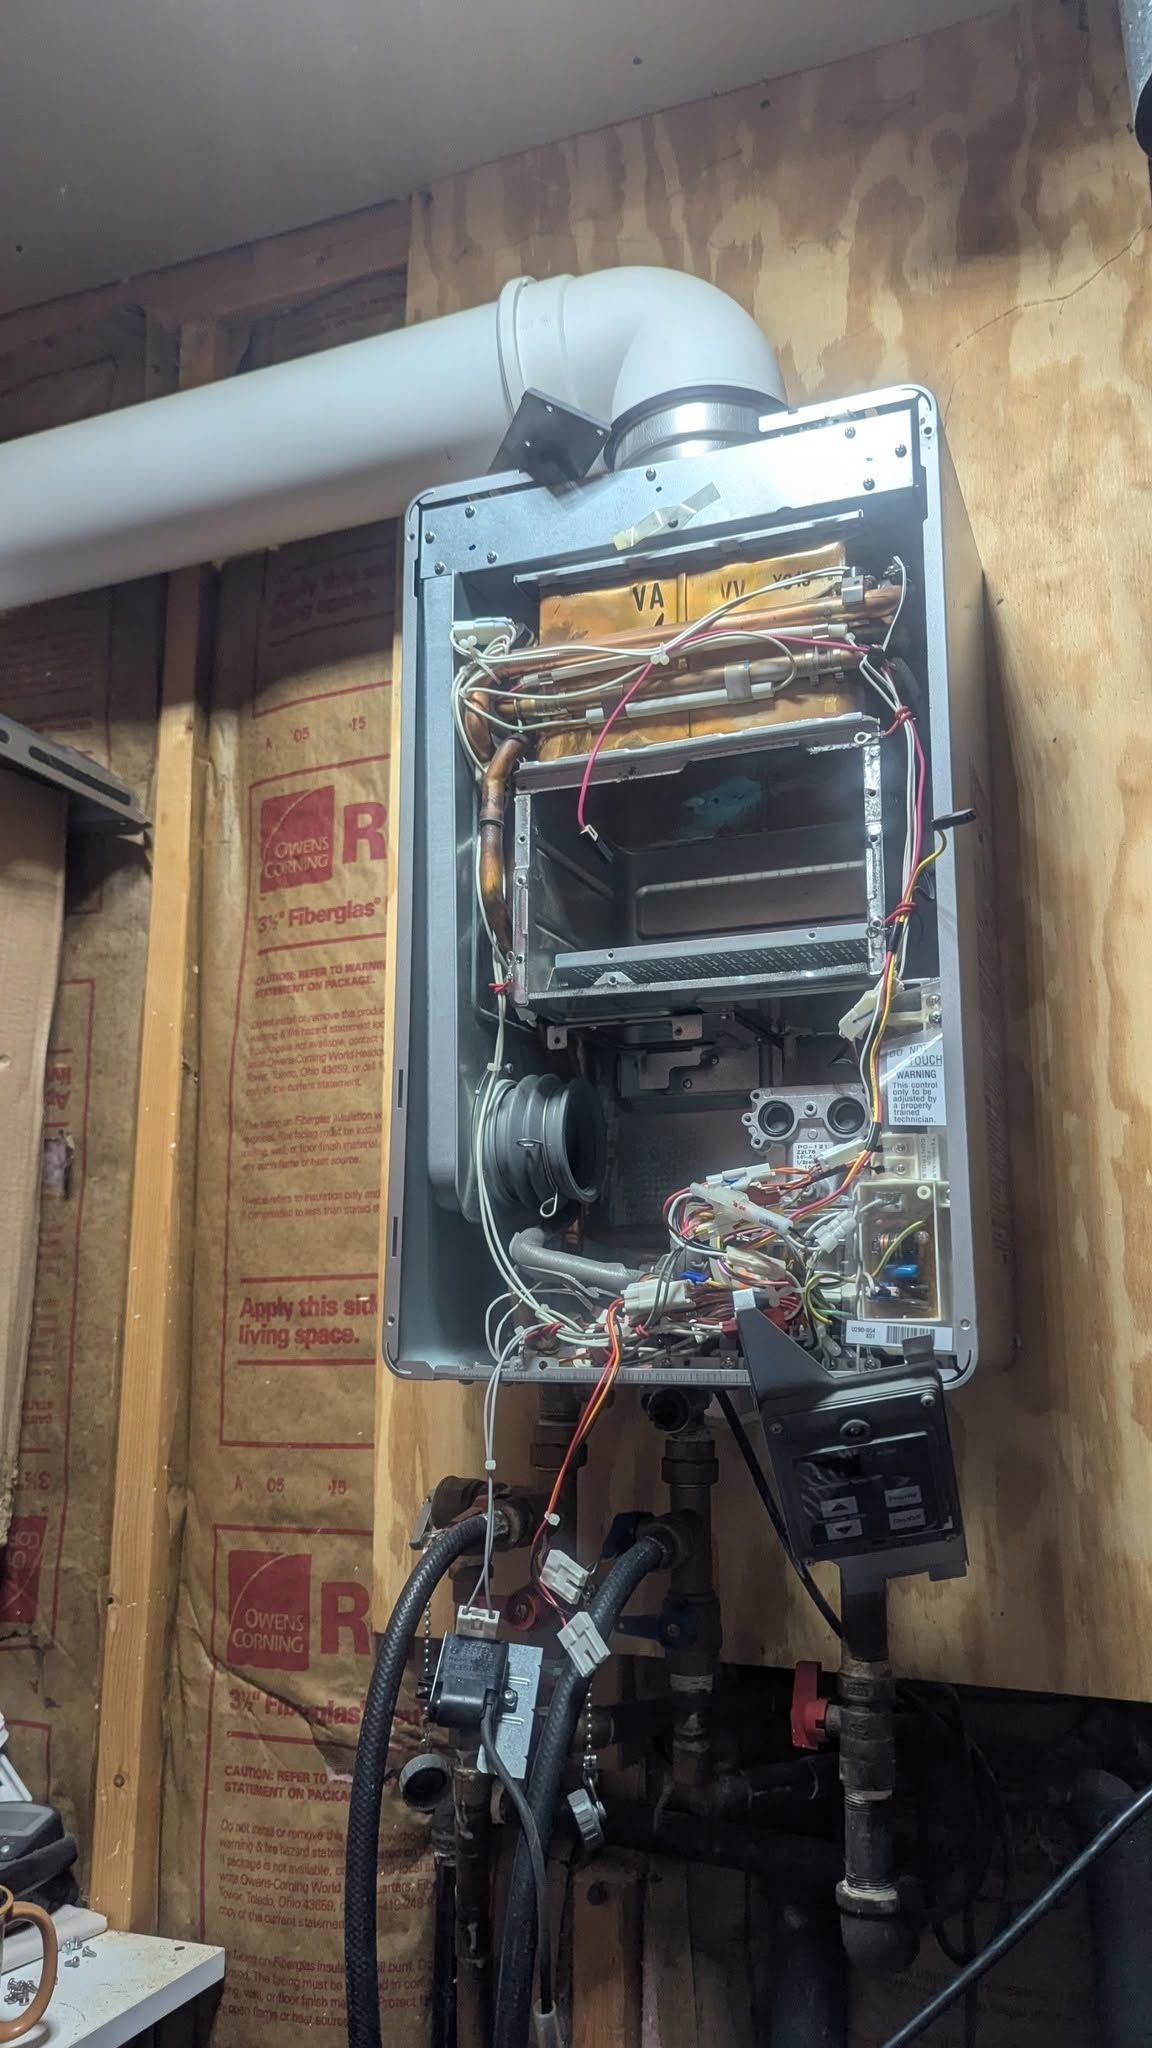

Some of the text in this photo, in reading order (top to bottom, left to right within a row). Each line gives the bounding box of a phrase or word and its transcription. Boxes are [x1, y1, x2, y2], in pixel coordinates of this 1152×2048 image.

[342, 802, 387, 865] R
[274, 836, 329, 859] OWENS
[264, 853, 329, 880] CORNING
[893, 1081, 938, 1089] This control
[896, 1070, 937, 1079] WARNING
[893, 1088, 909, 1096] only
[893, 1095, 925, 1104] adjusted
[901, 1102, 932, 1111] properly
[894, 1116, 937, 1124] technician.
[240, 1293, 378, 1323] Apply this sid
[239, 1324, 360, 1350] living space.
[245, 1608, 305, 1632] OWENS
[320, 1581, 371, 1656] R
[232, 1628, 304, 1654] CORNING
[224, 1765, 274, 1781] CAUTION:
[277, 1770, 310, 1783] REFER
[313, 1773, 328, 1784] TO
[224, 1781, 350, 1803] STATEMENT ON PACKA
[297, 1918, 344, 1931] statemen
